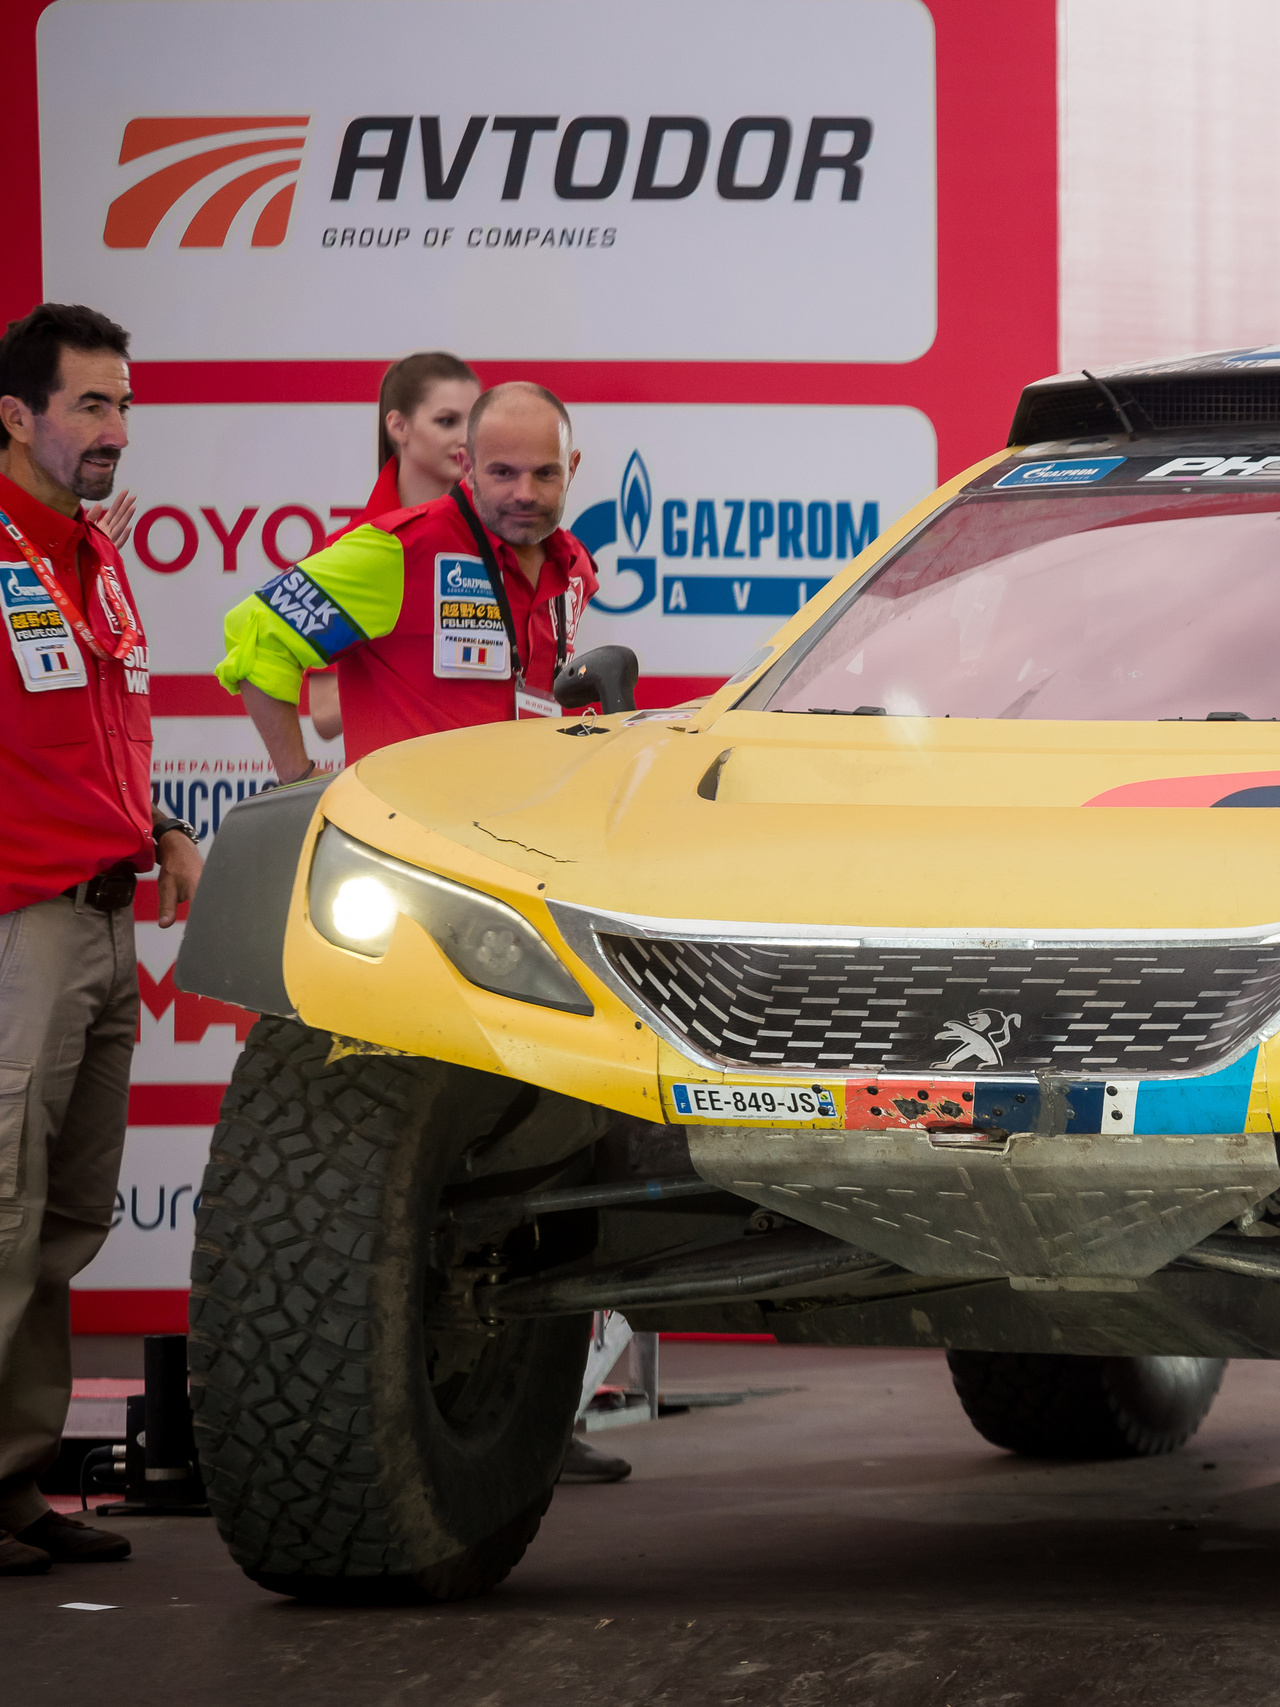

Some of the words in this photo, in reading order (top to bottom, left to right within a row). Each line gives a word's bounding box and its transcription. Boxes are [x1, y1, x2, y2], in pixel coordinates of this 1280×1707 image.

[331, 115, 875, 201] AVTODOR
[321, 227, 411, 248] GROUP
[423, 227, 455, 248] OF
[467, 227, 618, 248] COMPANIES
[269, 585, 326, 637] WAY
[283, 571, 341, 627] SILK
[123, 646, 149, 669] SIL
[125, 669, 149, 695] WA
[152, 759, 277, 774] ЕНЕРАЛЬНЫЙ
[693, 1089, 816, 1113] EE-849-JS
[111, 1183, 202, 1231] eur
